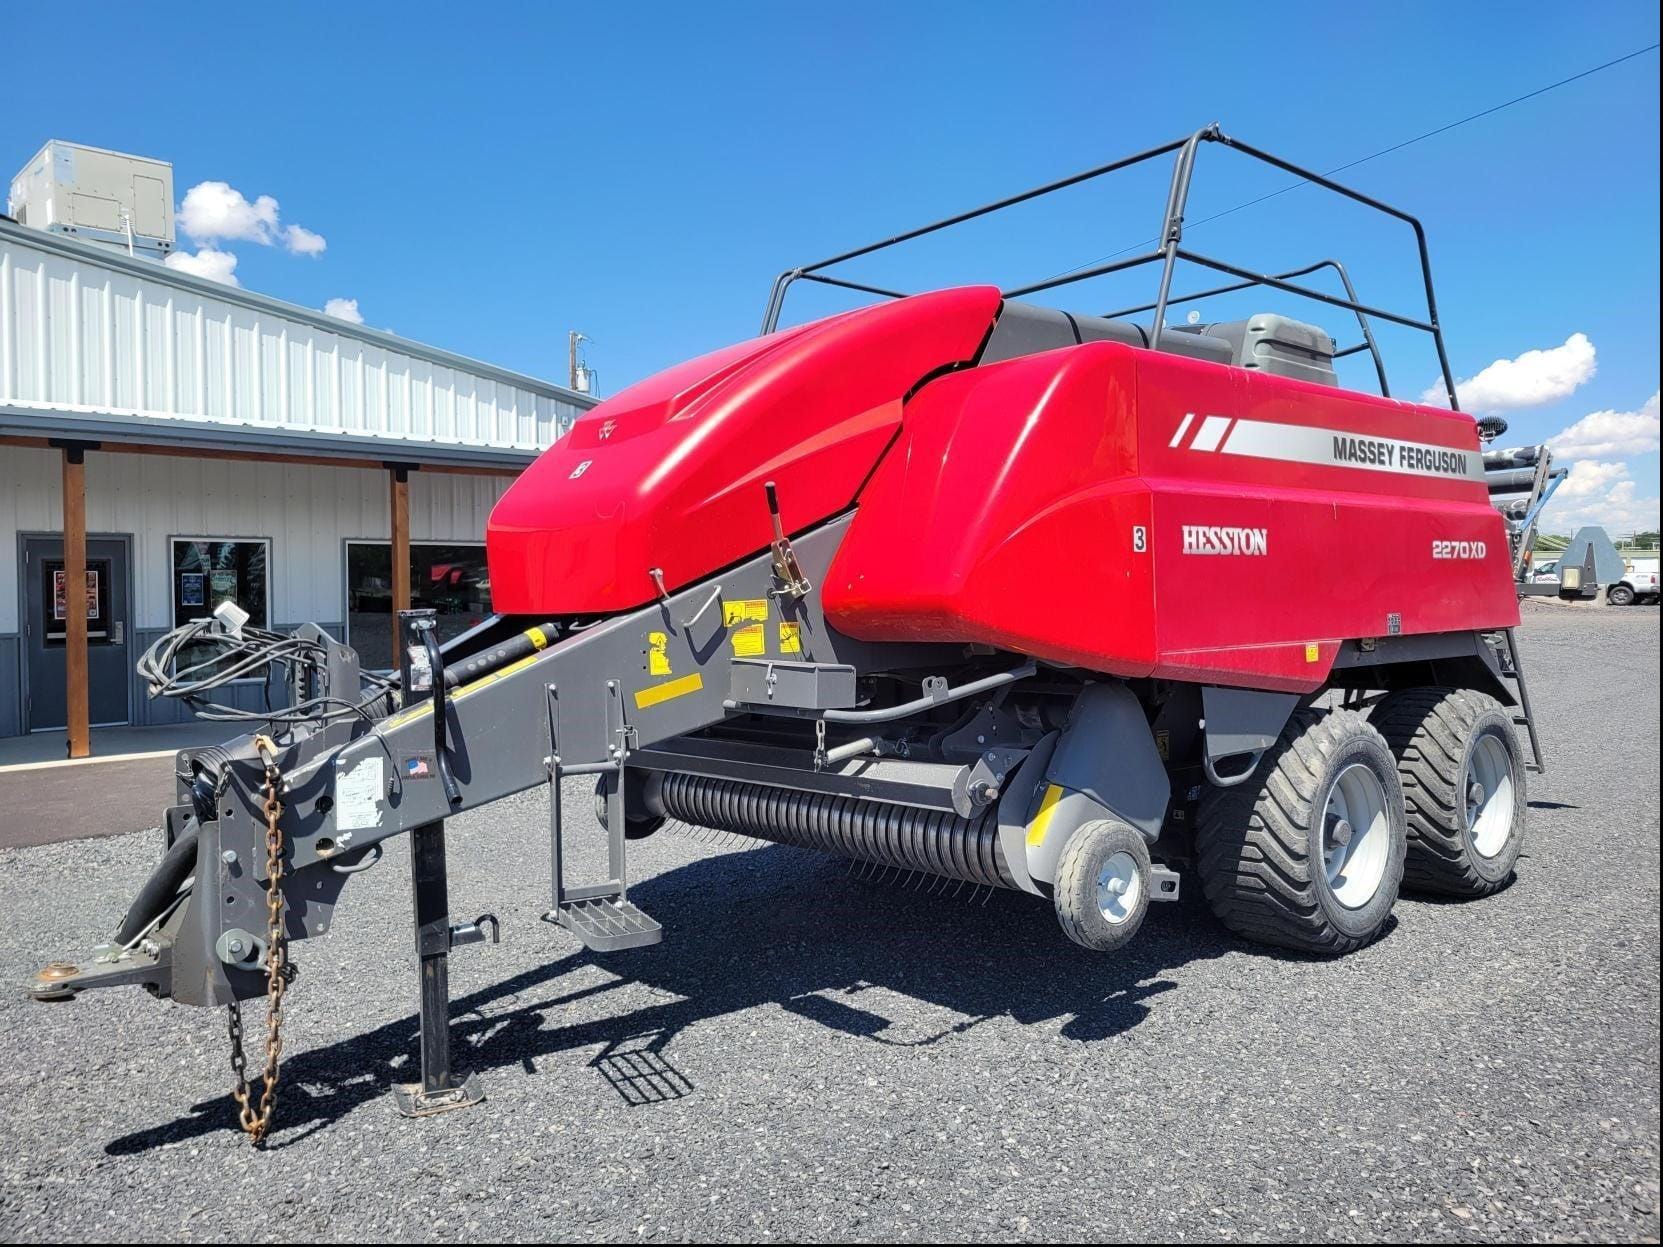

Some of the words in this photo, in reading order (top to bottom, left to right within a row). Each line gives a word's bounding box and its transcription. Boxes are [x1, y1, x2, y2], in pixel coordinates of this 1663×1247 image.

[1333, 436, 1395, 467] MASSEY
[1399, 445, 1467, 475] FERGUSON
[1135, 527, 1145, 551] 3
[1181, 525, 1268, 556] HESSTON
[1432, 540, 1487, 559] 2270XD
